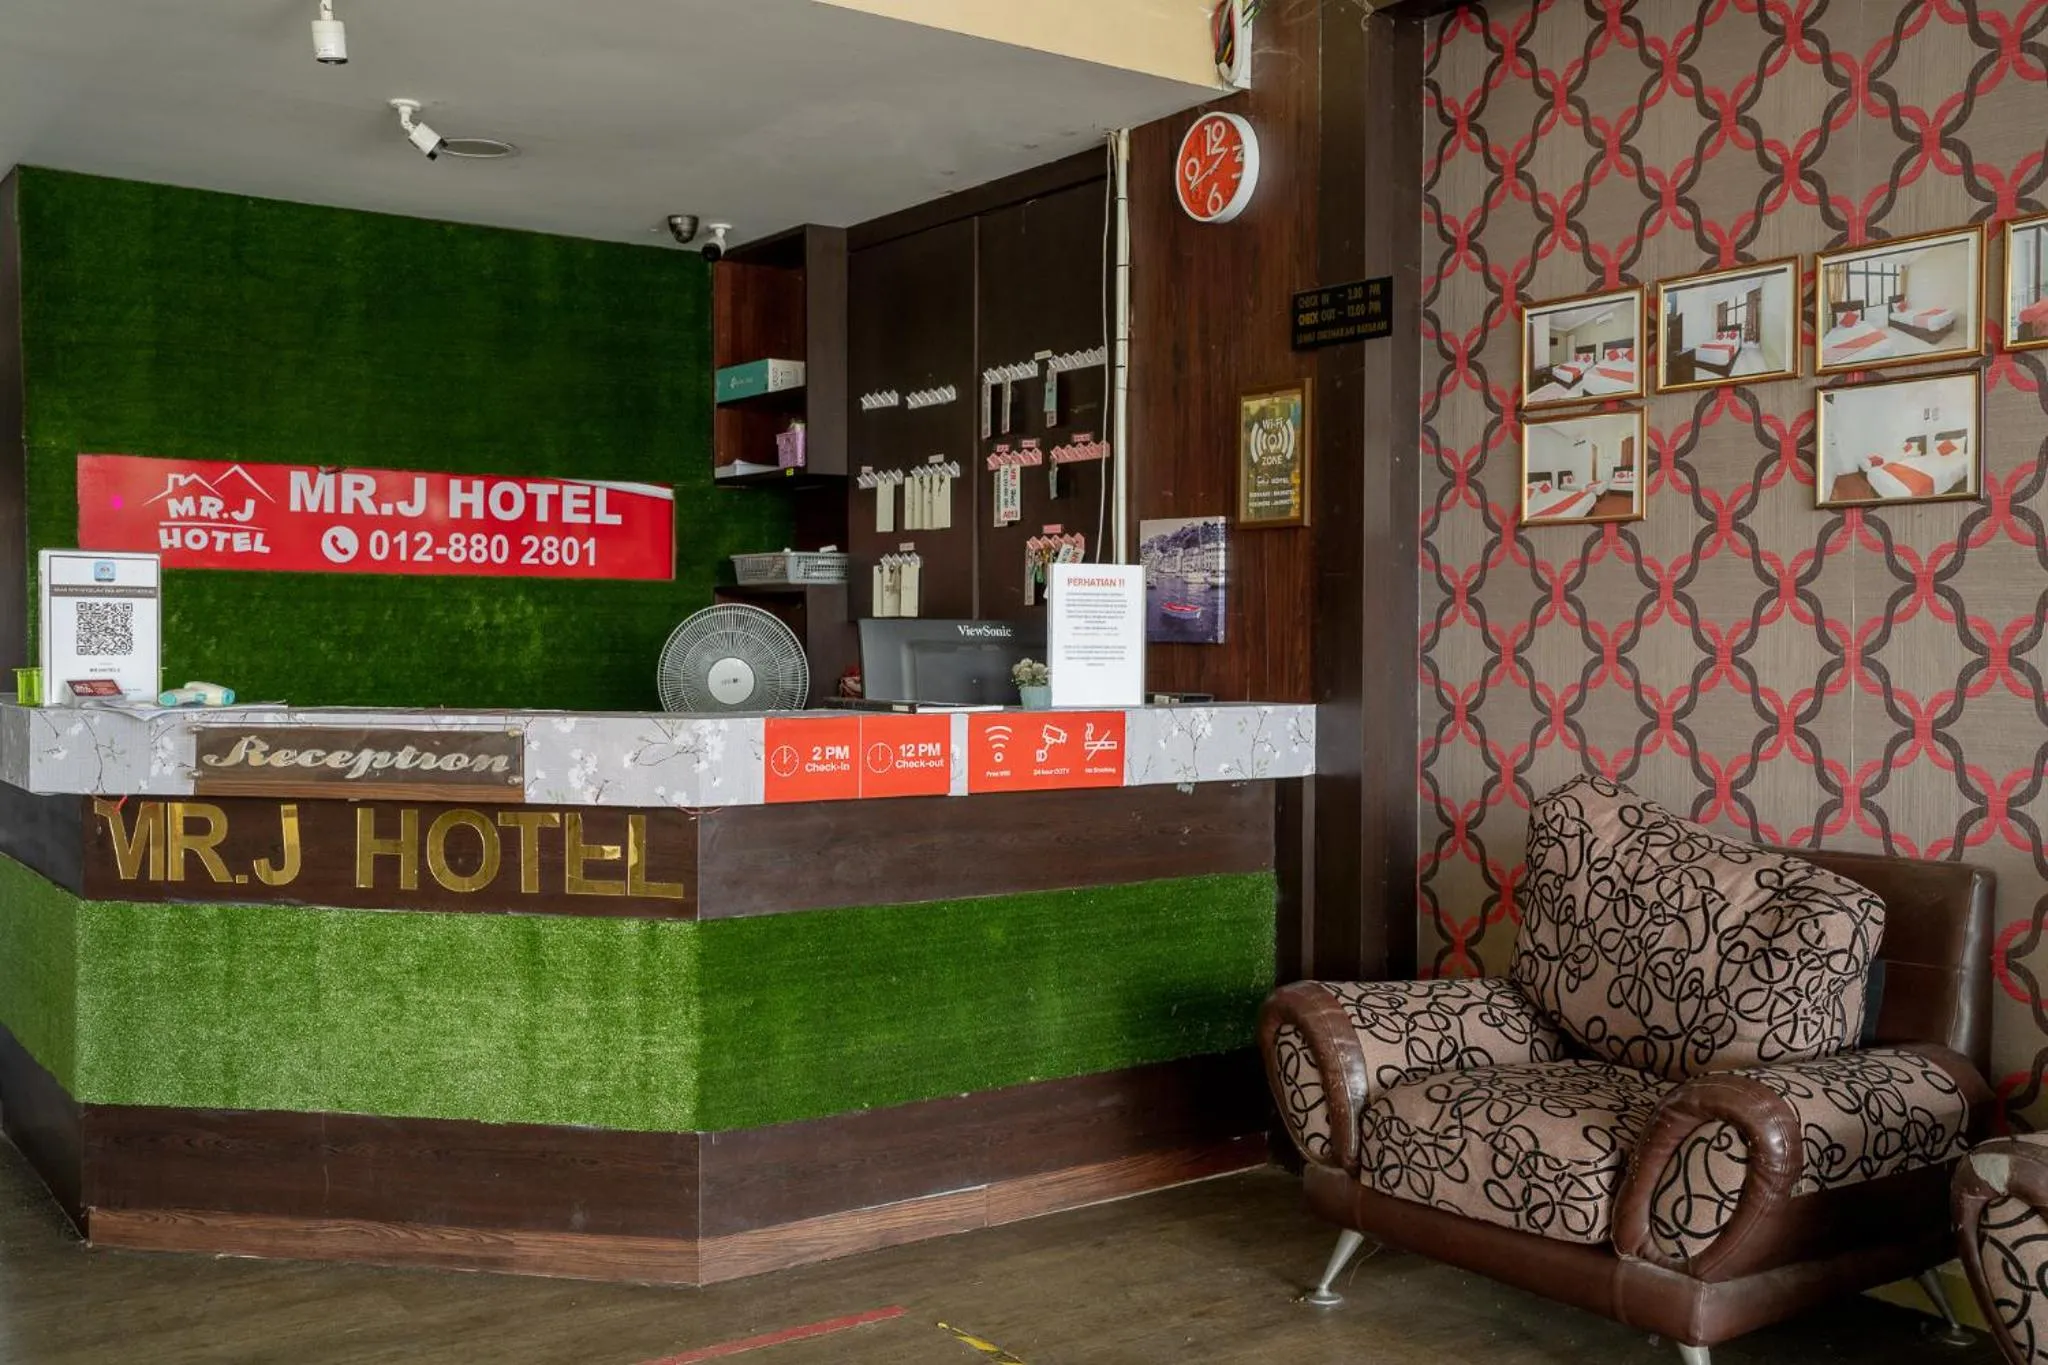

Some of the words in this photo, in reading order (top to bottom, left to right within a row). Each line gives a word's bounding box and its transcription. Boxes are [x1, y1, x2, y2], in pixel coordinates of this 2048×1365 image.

[1204, 120, 1228, 156] 12
[1207, 182, 1223, 216] 6
[1298, 309, 1319, 326] CHECK
[1321, 308, 1337, 322] OUT
[1262, 417, 1284, 430] Wi-Fi
[1261, 455, 1282, 466] ZONE
[288, 470, 427, 518] MR.J
[448, 479, 623, 526] HOTEL
[166, 494, 256, 523] MR.J
[158, 527, 272, 554] HOTEL
[368, 529, 509, 564] 012-880
[520, 535, 597, 567] 2801
[1067, 577, 1117, 588] PERHATIAN
[956, 624, 1012, 637] ViewSonic
[202, 734, 511, 779] Reception
[812, 746, 822, 761] 2
[825, 745, 850, 760] PM
[898, 743, 915, 758] 12
[918, 742, 941, 757] PM
[804, 761, 850, 773] Check-in
[895, 757, 945, 770] Check-out
[354, 805, 685, 899] HOTEL
